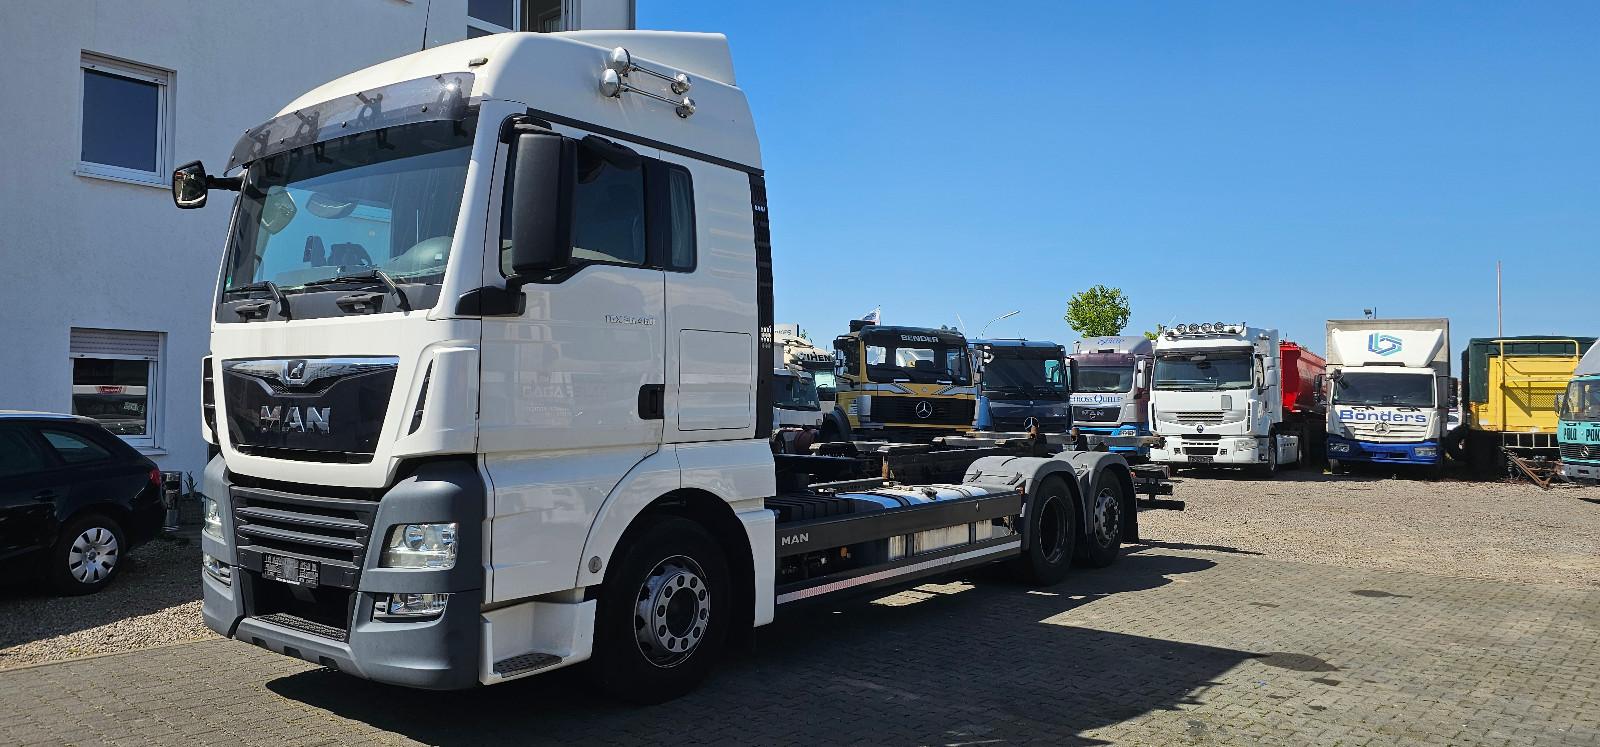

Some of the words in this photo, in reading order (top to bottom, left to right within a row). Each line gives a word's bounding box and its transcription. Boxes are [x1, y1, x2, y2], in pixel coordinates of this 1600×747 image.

[900, 334, 939, 343] BENDER
[260, 405, 331, 434] MAN
[1340, 409, 1426, 423] Bönders
[781, 532, 809, 546] MAN
